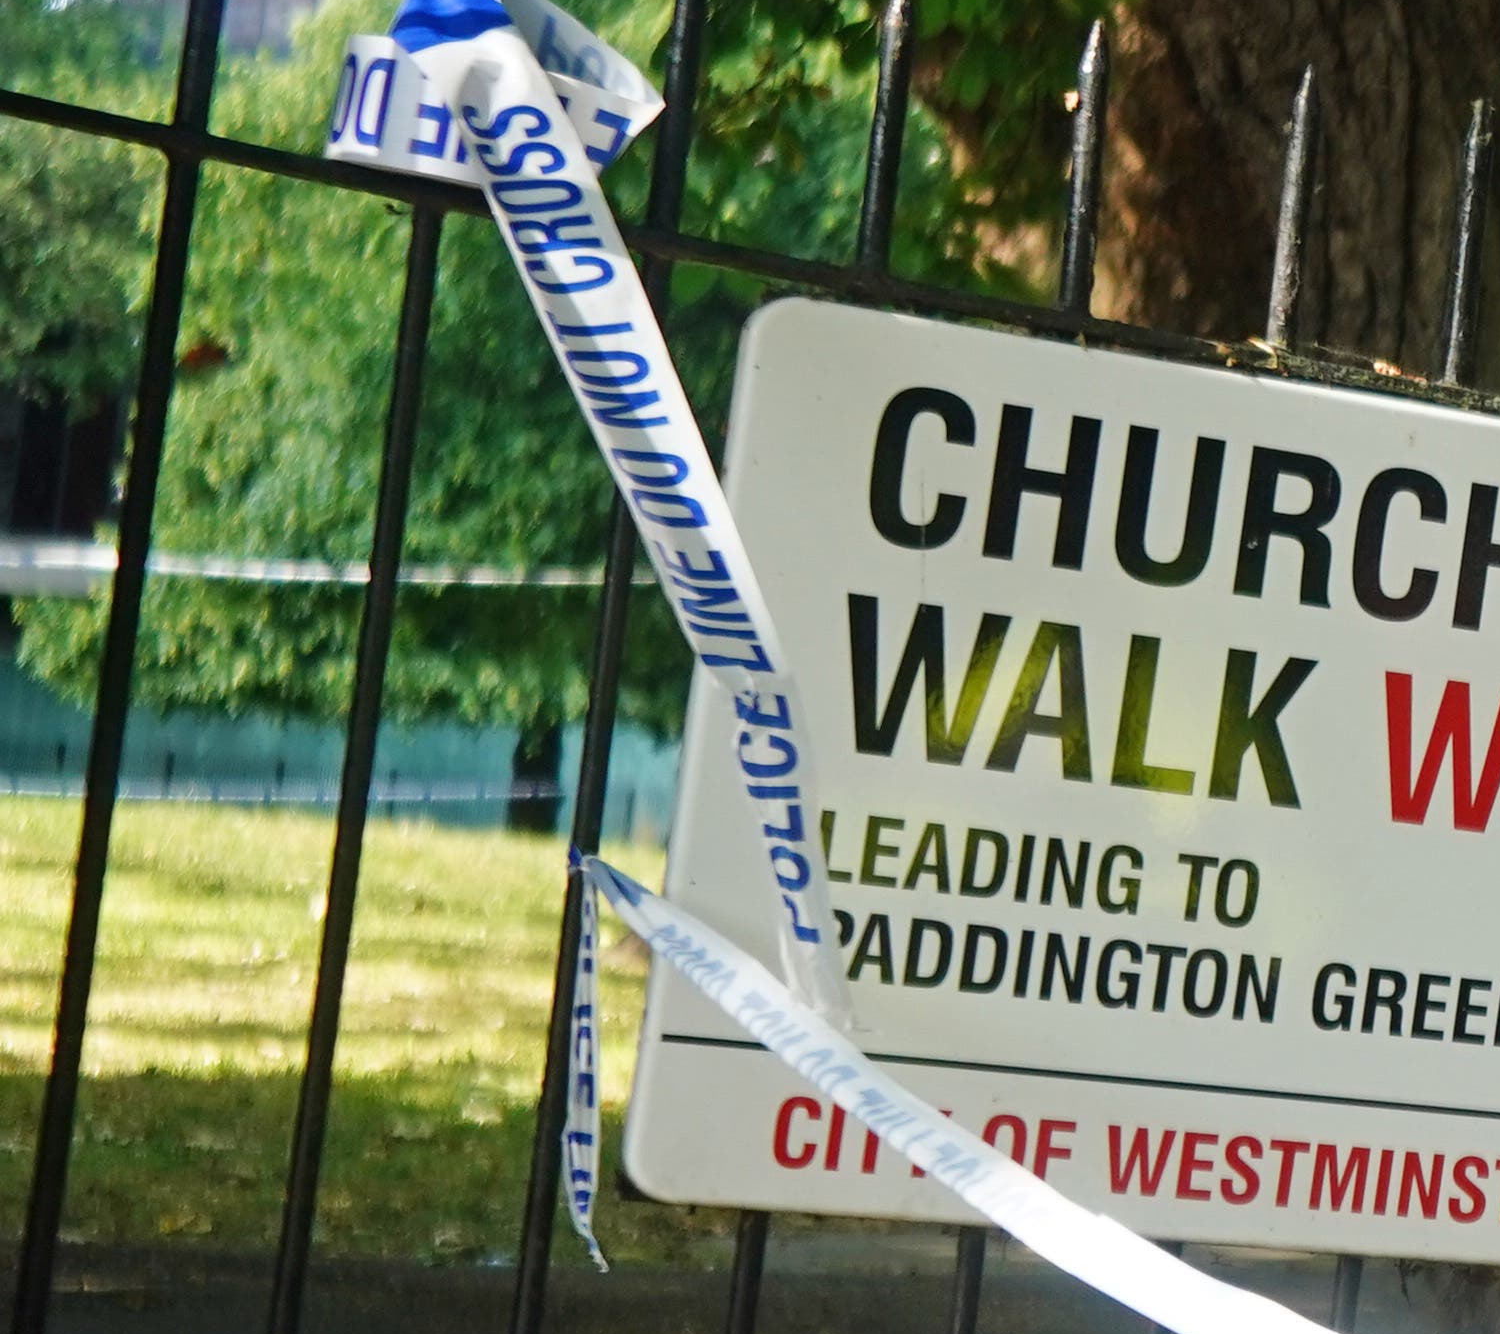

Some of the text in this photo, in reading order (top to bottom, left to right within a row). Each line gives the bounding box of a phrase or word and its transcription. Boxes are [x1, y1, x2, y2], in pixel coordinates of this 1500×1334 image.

[462, 104, 616, 296] CROSS
[546, 310, 669, 430] NOT
[612, 447, 710, 530] DO
[653, 541, 776, 674] LINE
[847, 593, 1319, 812] WALK
[819, 810, 1262, 930] LEADING TO
[981, 1113, 1079, 1181] OF
